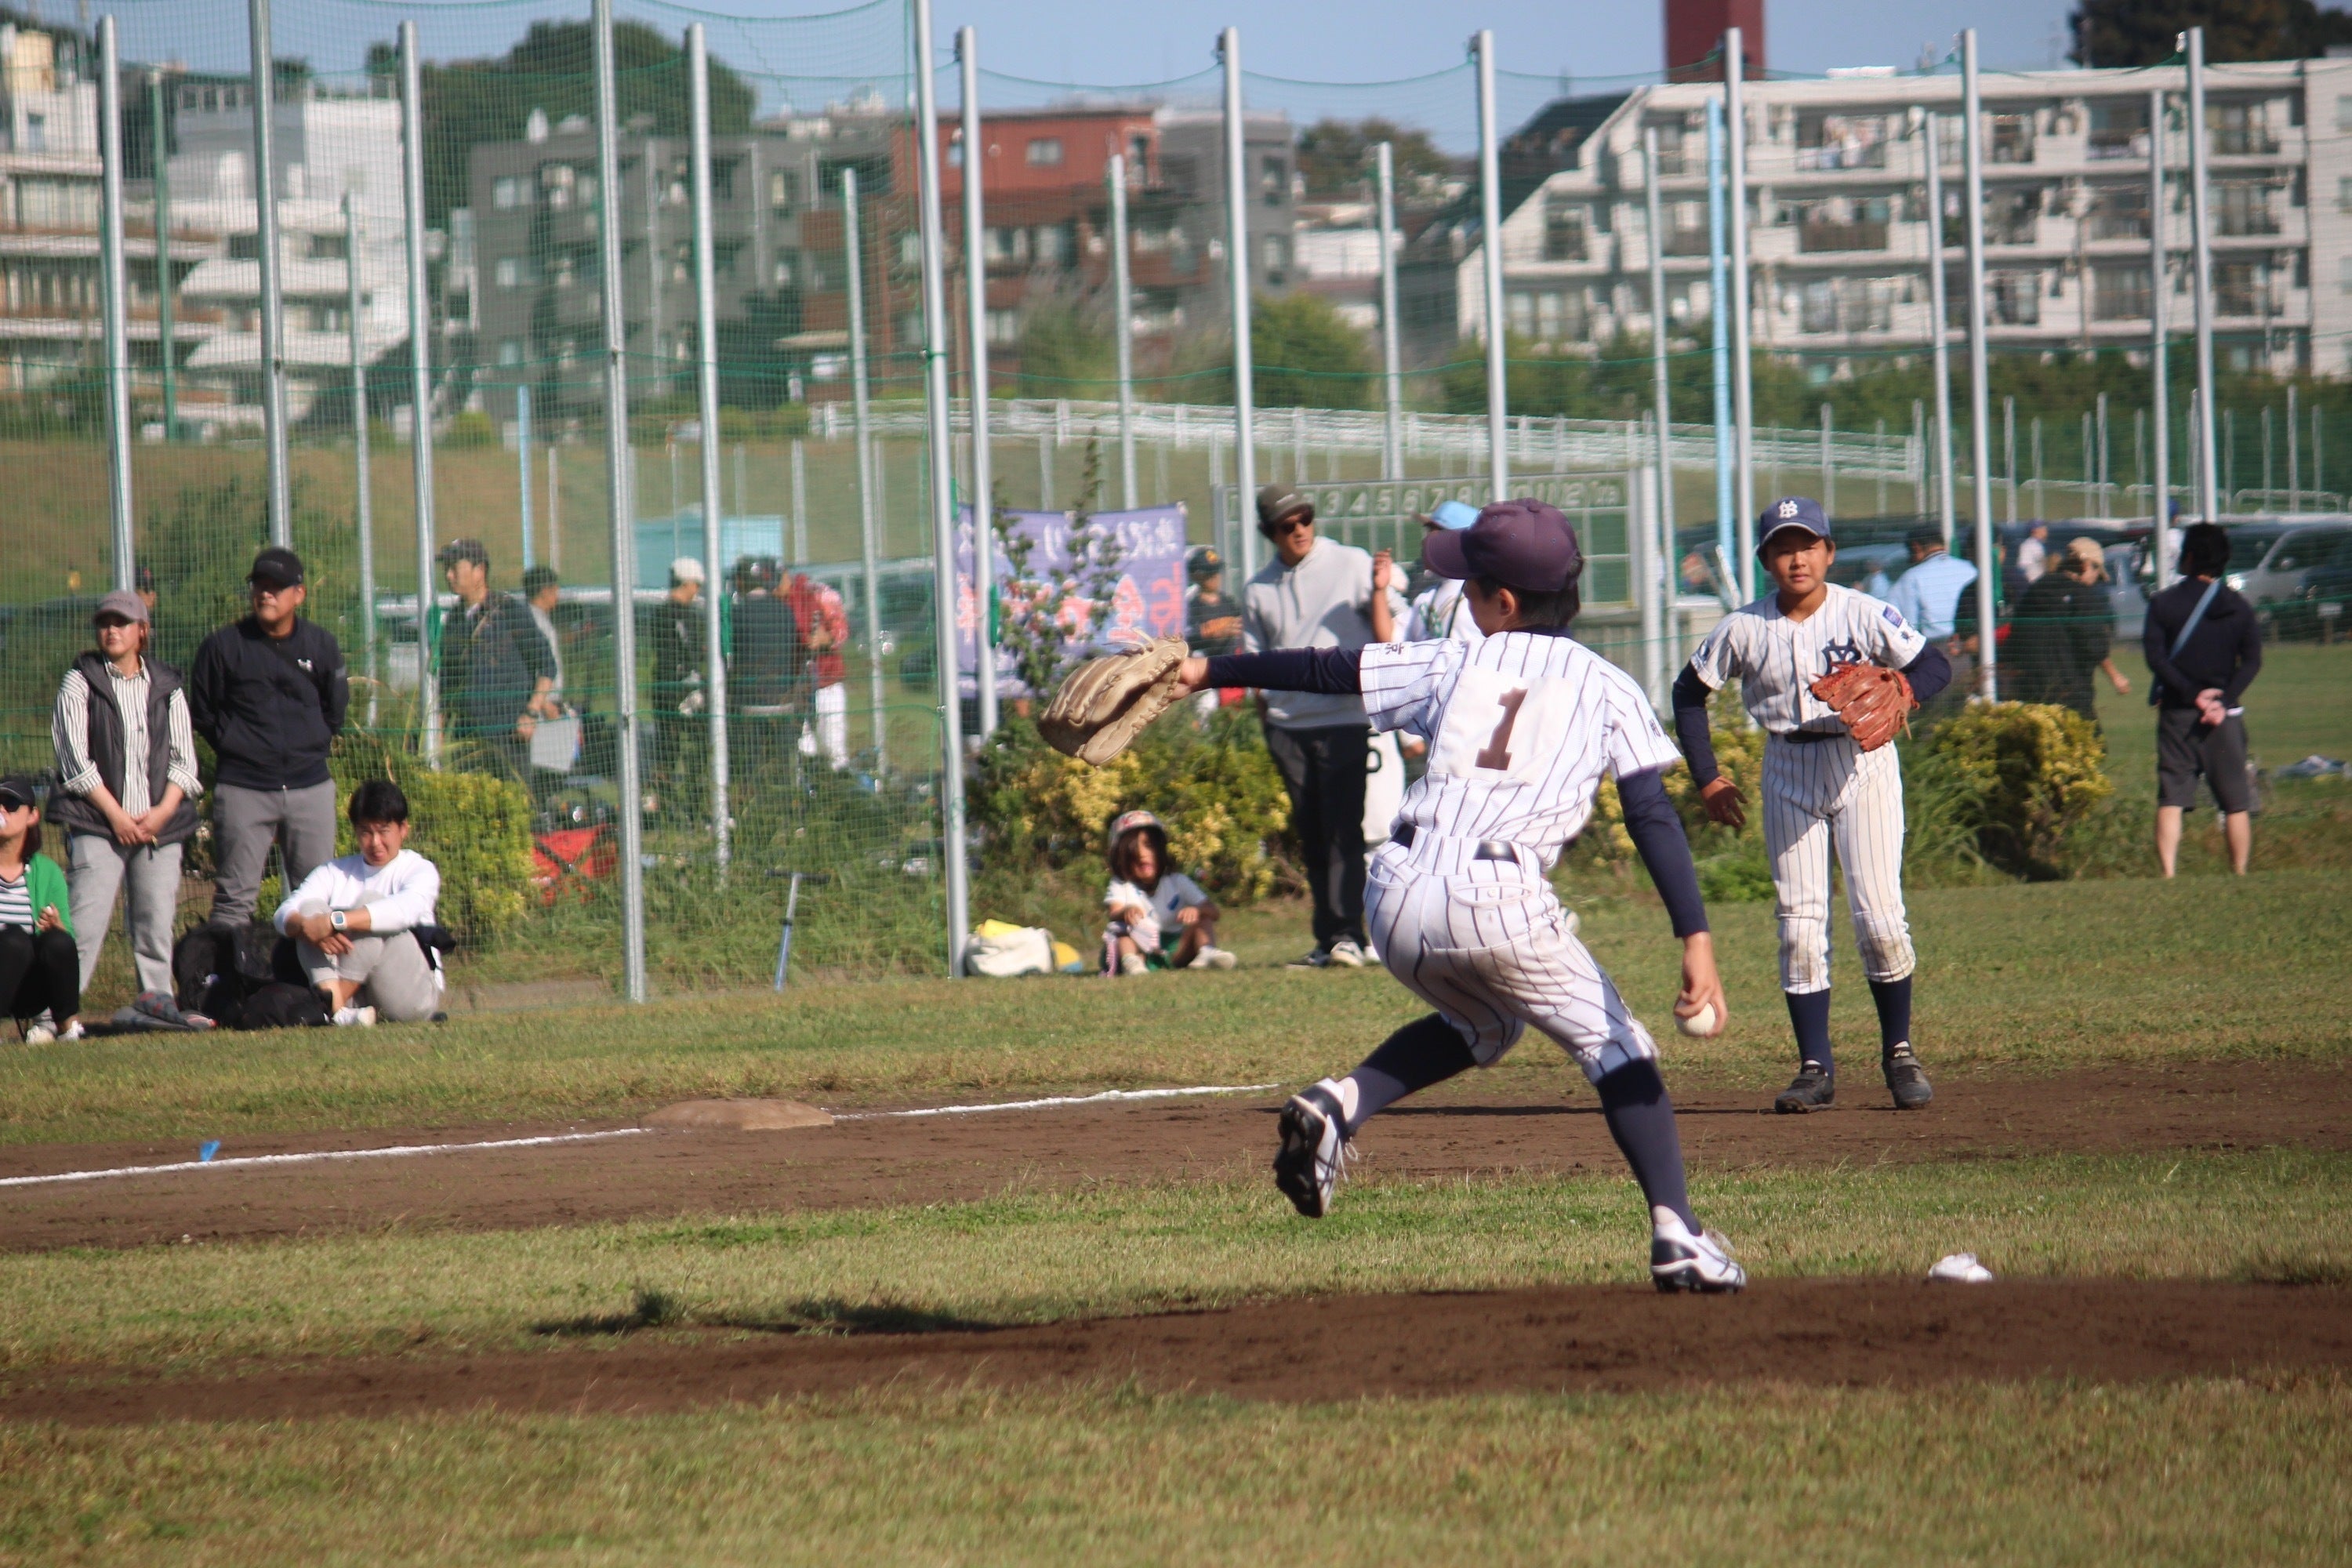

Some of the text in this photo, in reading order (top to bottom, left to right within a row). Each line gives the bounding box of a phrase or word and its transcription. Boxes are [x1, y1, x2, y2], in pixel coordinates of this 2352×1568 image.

[1323, 489, 1341, 514] 3
[1348, 492, 1368, 513] 4
[1377, 488, 1394, 513] 5
[1403, 488, 1420, 512] 6
[1429, 487, 1446, 510] 7
[1475, 686, 1529, 771] 1
